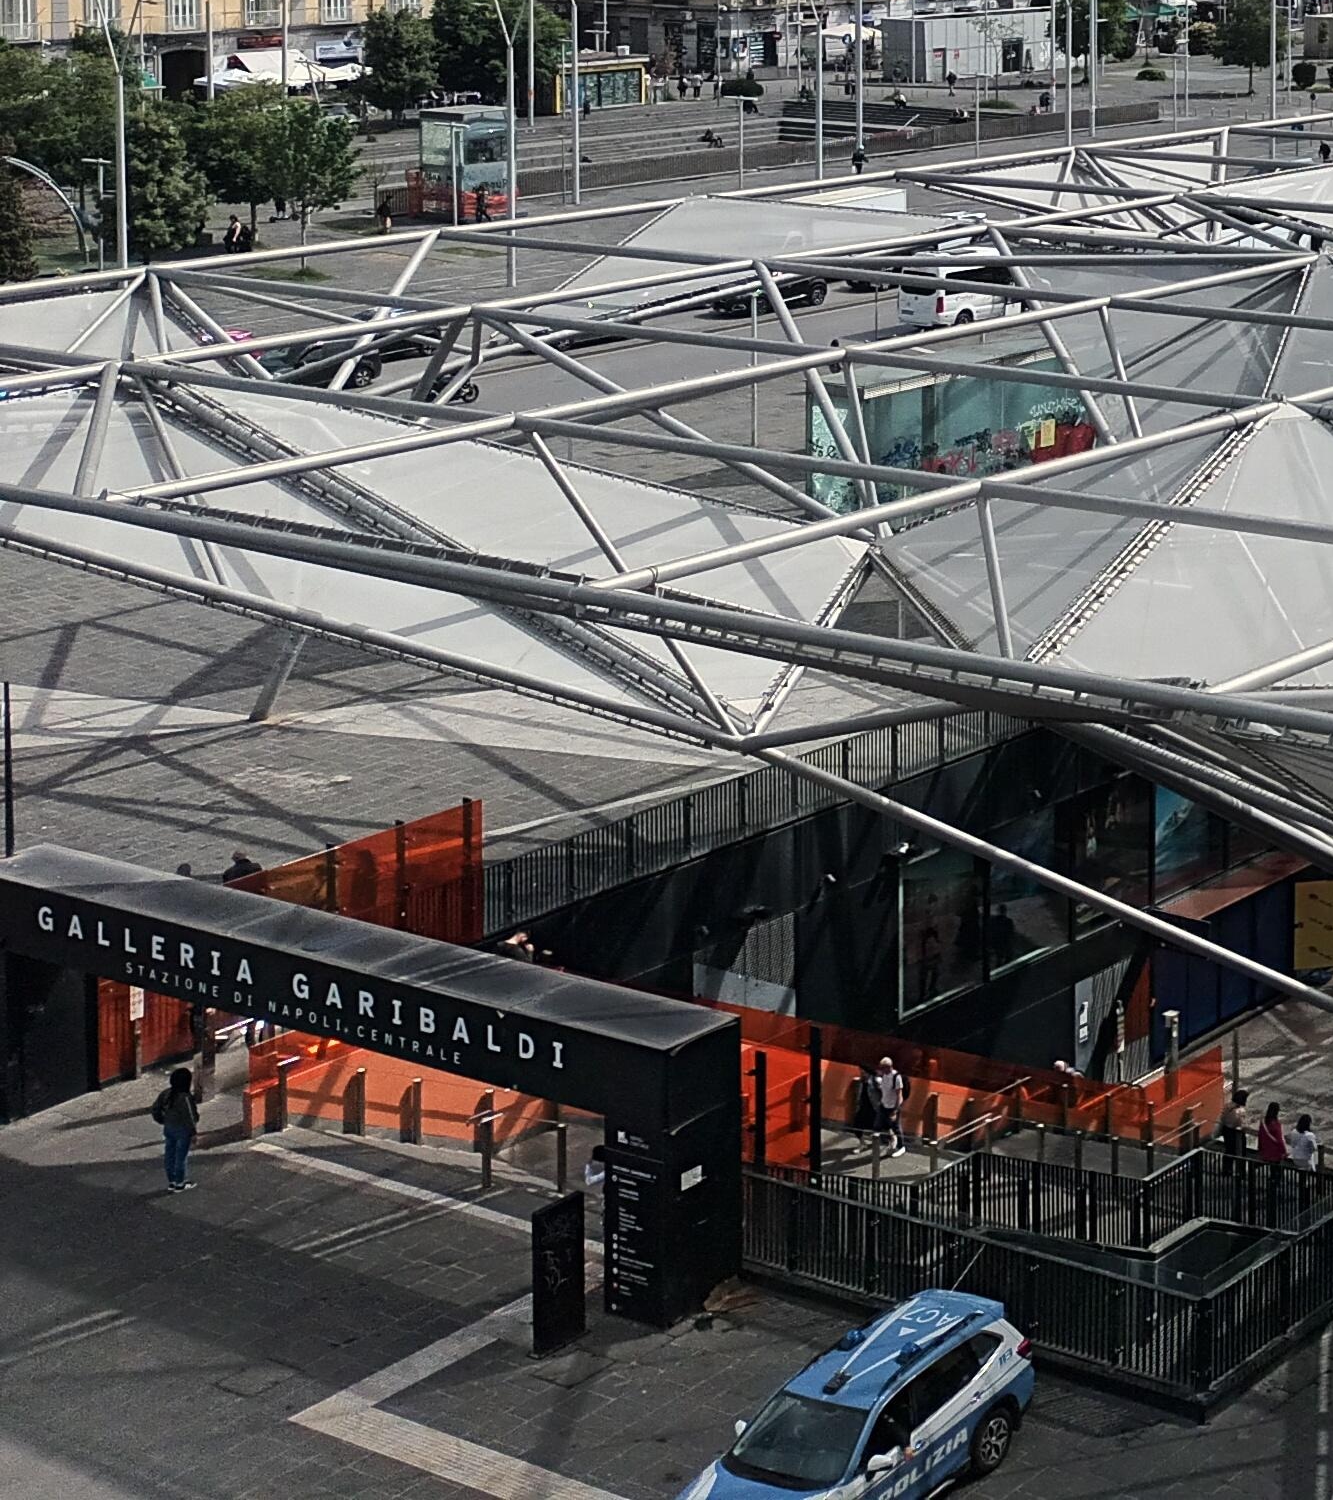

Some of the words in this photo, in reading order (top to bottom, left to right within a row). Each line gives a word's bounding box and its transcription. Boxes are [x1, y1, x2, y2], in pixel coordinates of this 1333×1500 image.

[37, 905, 254, 986] GALLERIA
[292, 972, 565, 1069] GARIBALDI
[125, 961, 220, 999] STAZIONE
[233, 990, 253, 1007] DI
[267, 1000, 342, 1032] NAPOLI
[356, 1024, 462, 1065] CENTRALE
[877, 1427, 969, 1500] POLIZIA
